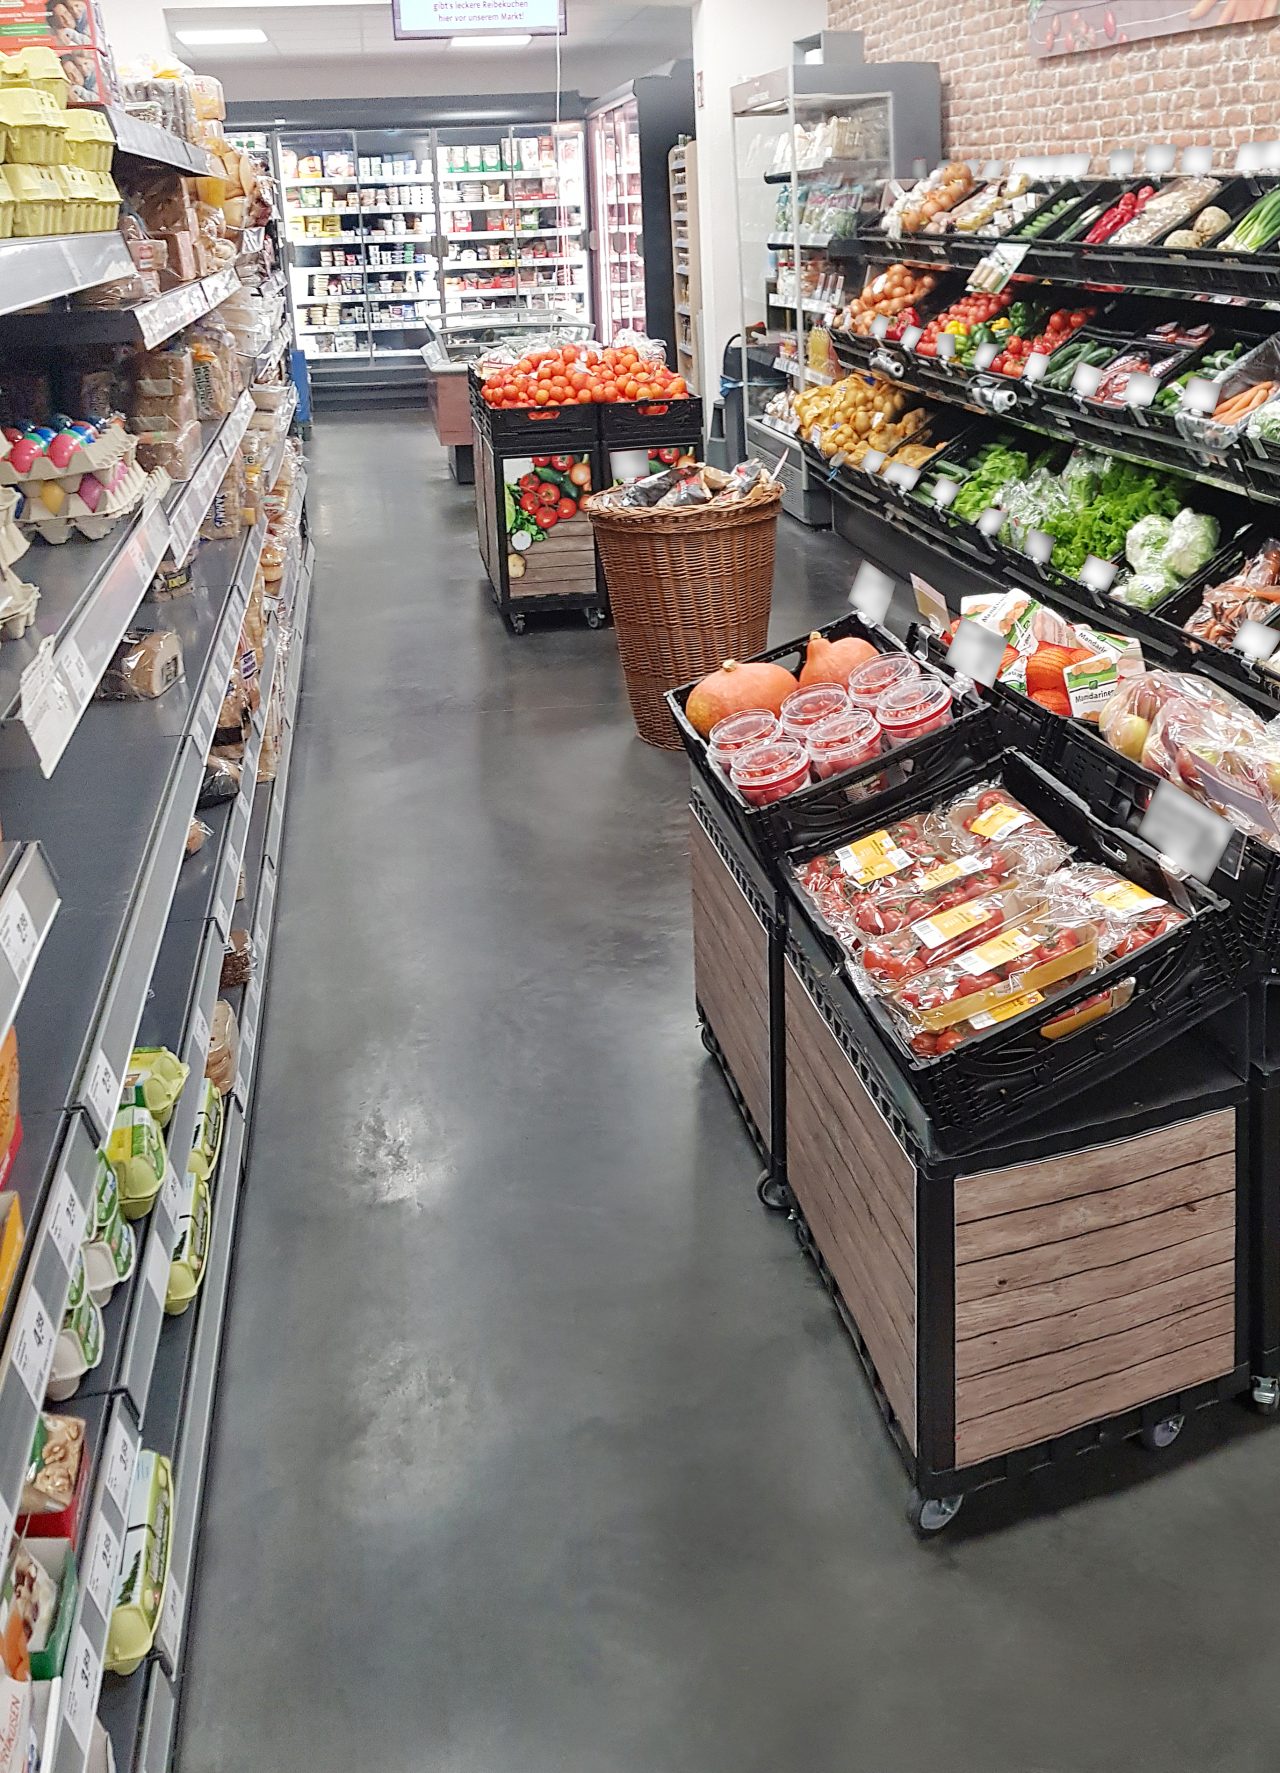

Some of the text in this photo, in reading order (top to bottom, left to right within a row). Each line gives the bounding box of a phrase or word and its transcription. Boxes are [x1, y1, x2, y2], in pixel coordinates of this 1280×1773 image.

[455, 0, 481, 9] leckere
[502, 12, 524, 20] Markt!
[1075, 688, 1116, 703] Mandarine
